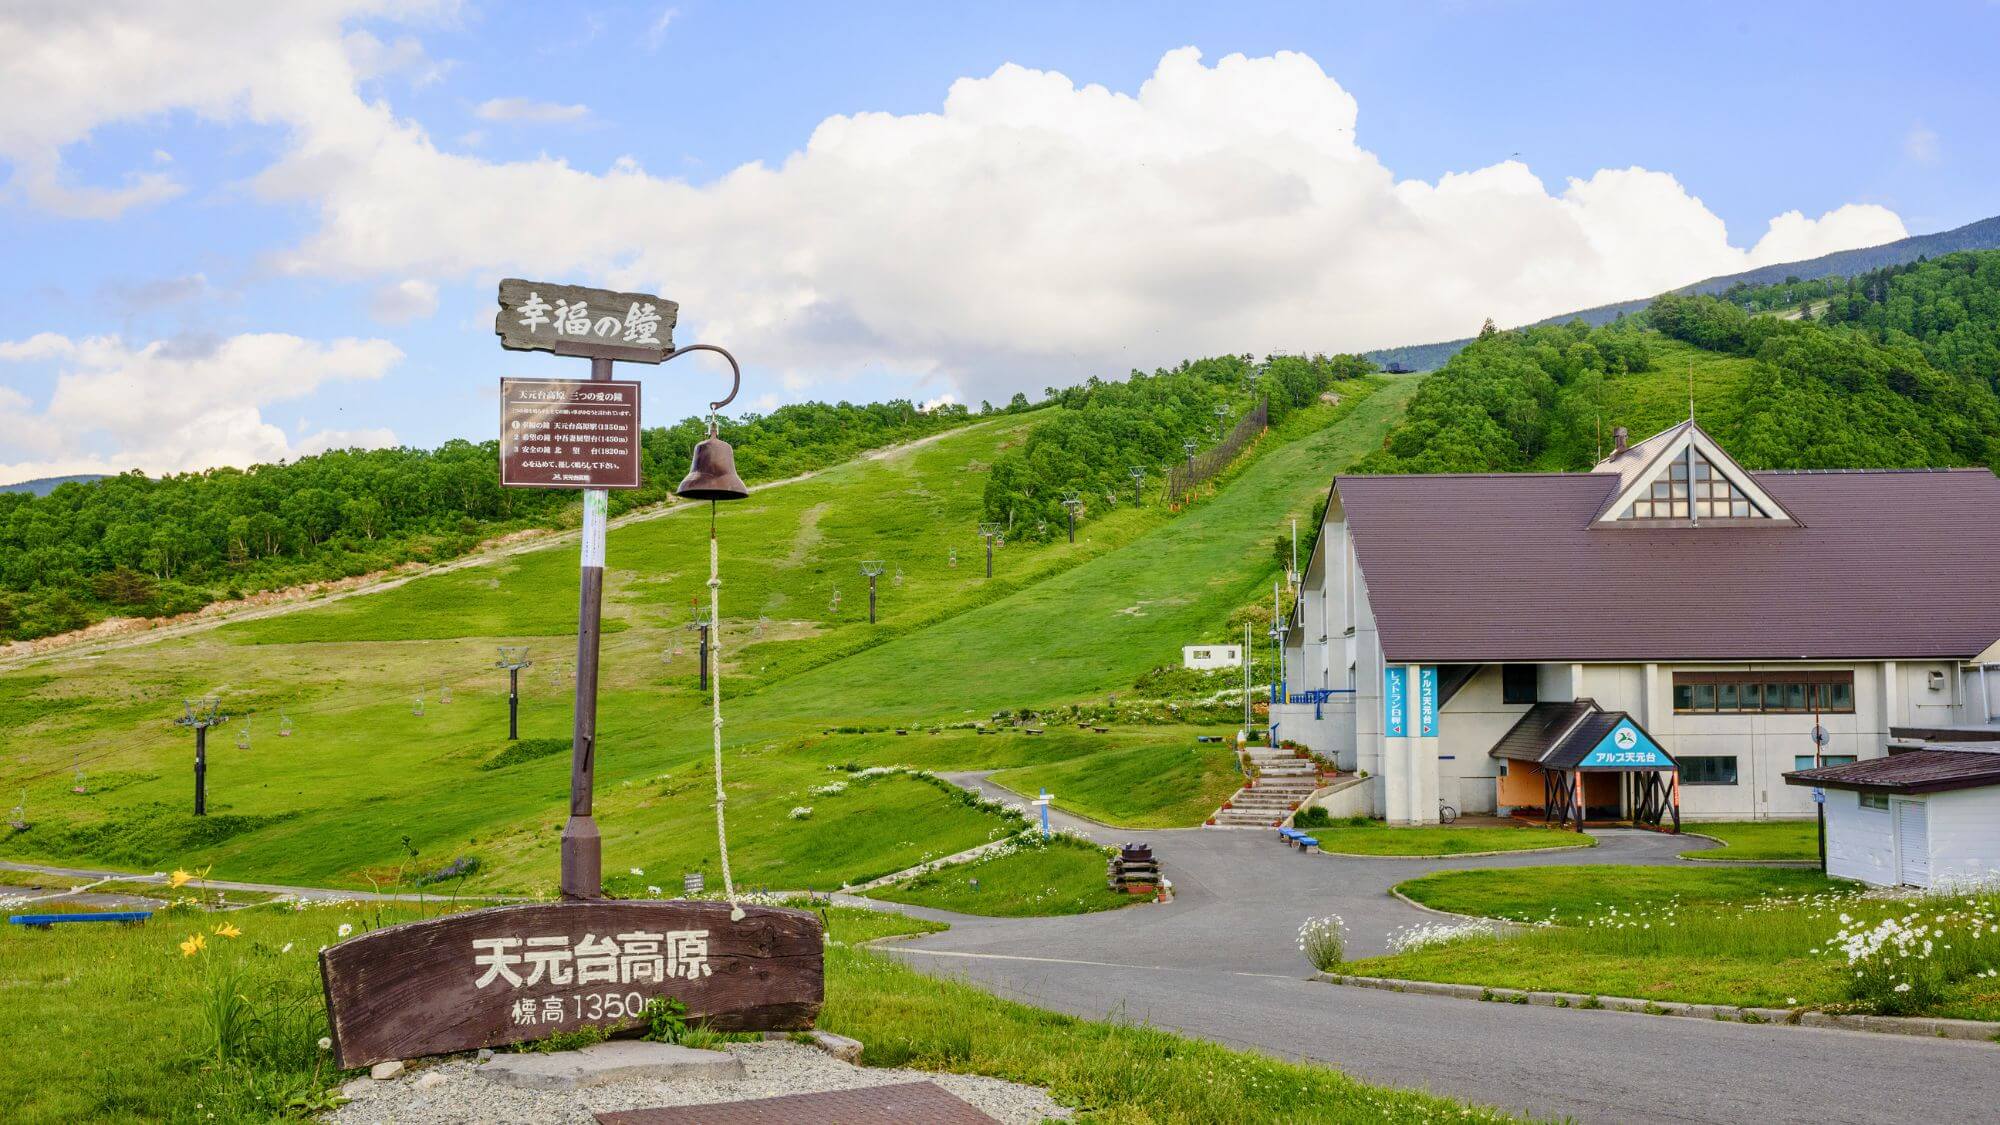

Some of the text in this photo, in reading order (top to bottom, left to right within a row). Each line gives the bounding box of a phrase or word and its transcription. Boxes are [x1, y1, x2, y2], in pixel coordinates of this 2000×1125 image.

[516, 292, 663, 345] 幸福の鐘
[472, 929, 713, 989] 天元台高原
[511, 995, 564, 1025] 標高
